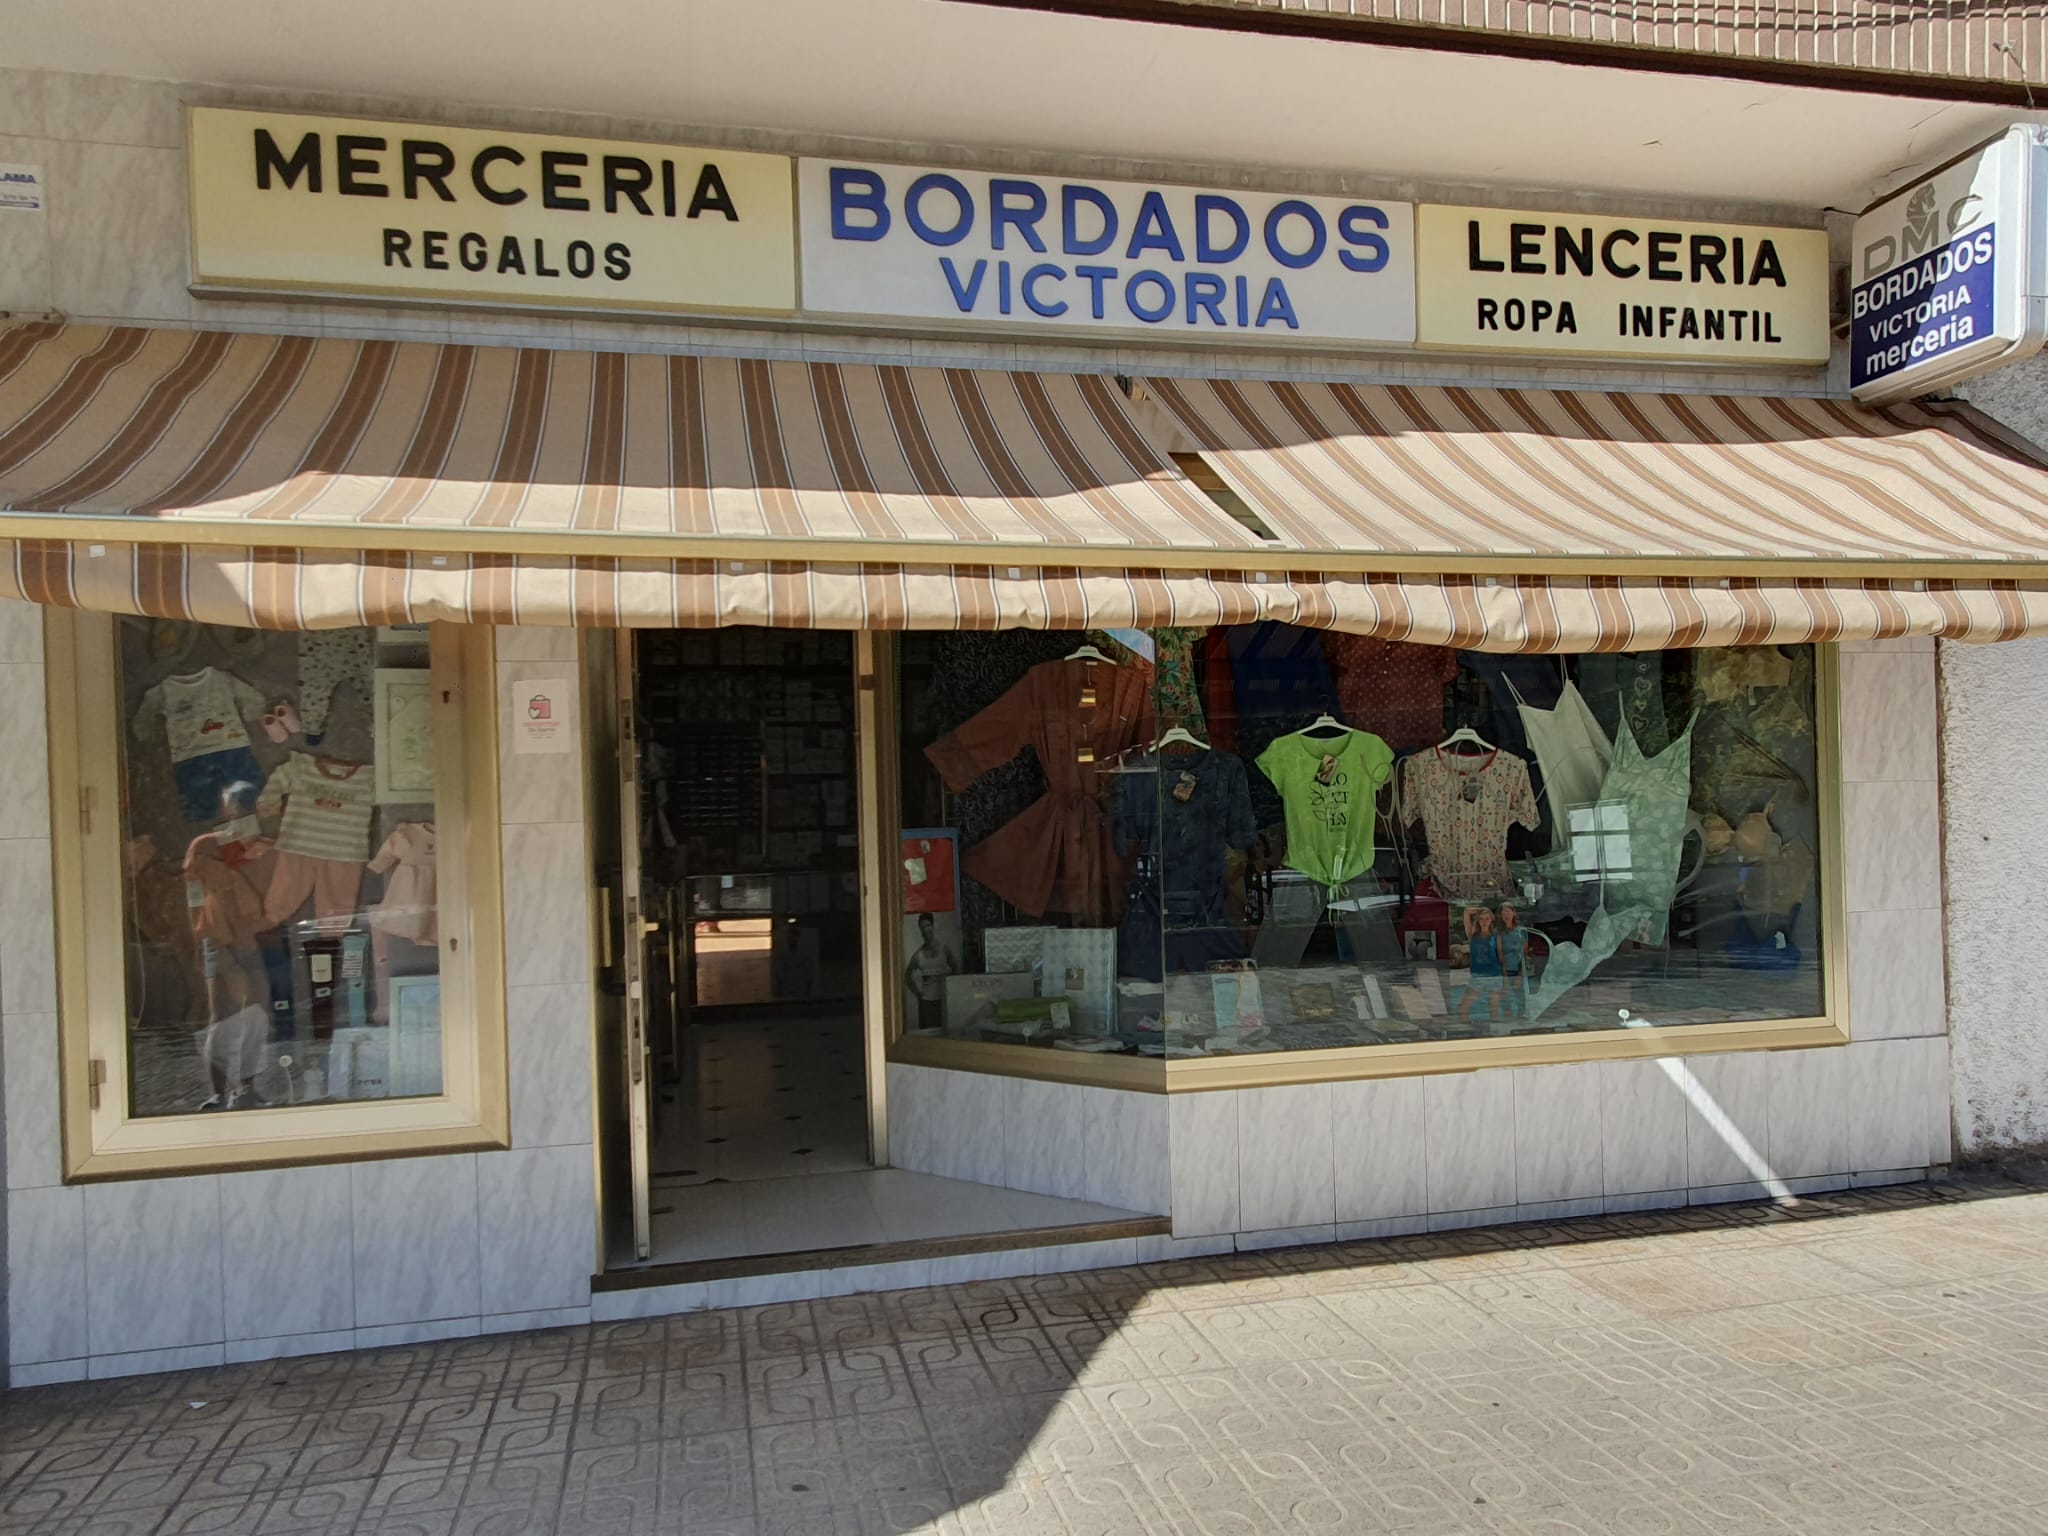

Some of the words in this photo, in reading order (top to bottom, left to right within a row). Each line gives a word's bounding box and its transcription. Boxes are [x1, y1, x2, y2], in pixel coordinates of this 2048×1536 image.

[253, 127, 740, 222] MERCERIA
[381, 228, 634, 281] REGALOS
[829, 166, 1391, 273] BORDADOS
[1467, 220, 1788, 288] LENCERIA
[1862, 193, 1984, 281] DMC
[938, 256, 1300, 330] VICTORIA
[1853, 230, 1993, 321] BORDADOS
[1476, 297, 1578, 335] ROPA
[1618, 302, 1782, 343] INFANTIL
[1865, 314, 1974, 376] merceria
[1868, 285, 1972, 343] VICTORIA
